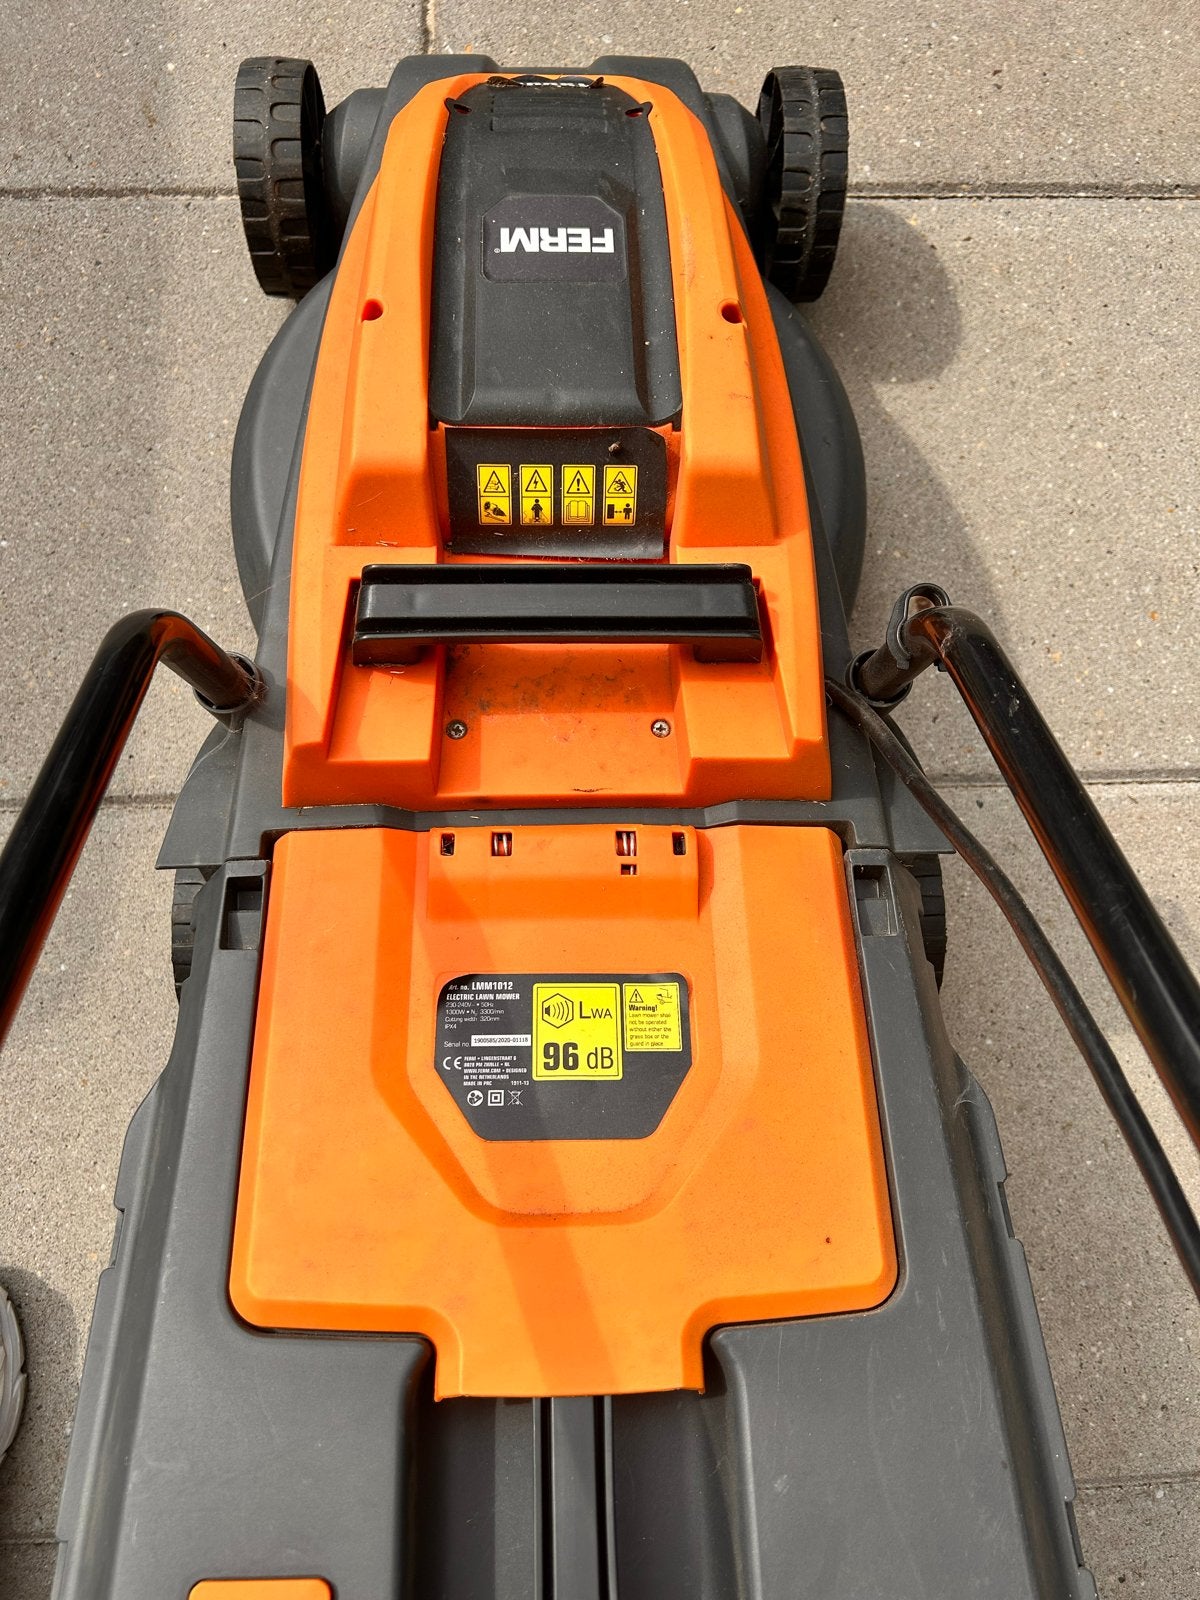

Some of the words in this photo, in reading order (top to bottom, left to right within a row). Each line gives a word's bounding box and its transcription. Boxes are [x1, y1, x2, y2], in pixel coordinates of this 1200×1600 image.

[500, 227, 615, 253] FERM
[472, 982, 513, 990] LMM1012
[629, 1004, 657, 1012] Warning!
[543, 1042, 579, 1071] 96
[587, 1047, 614, 1069] dB
